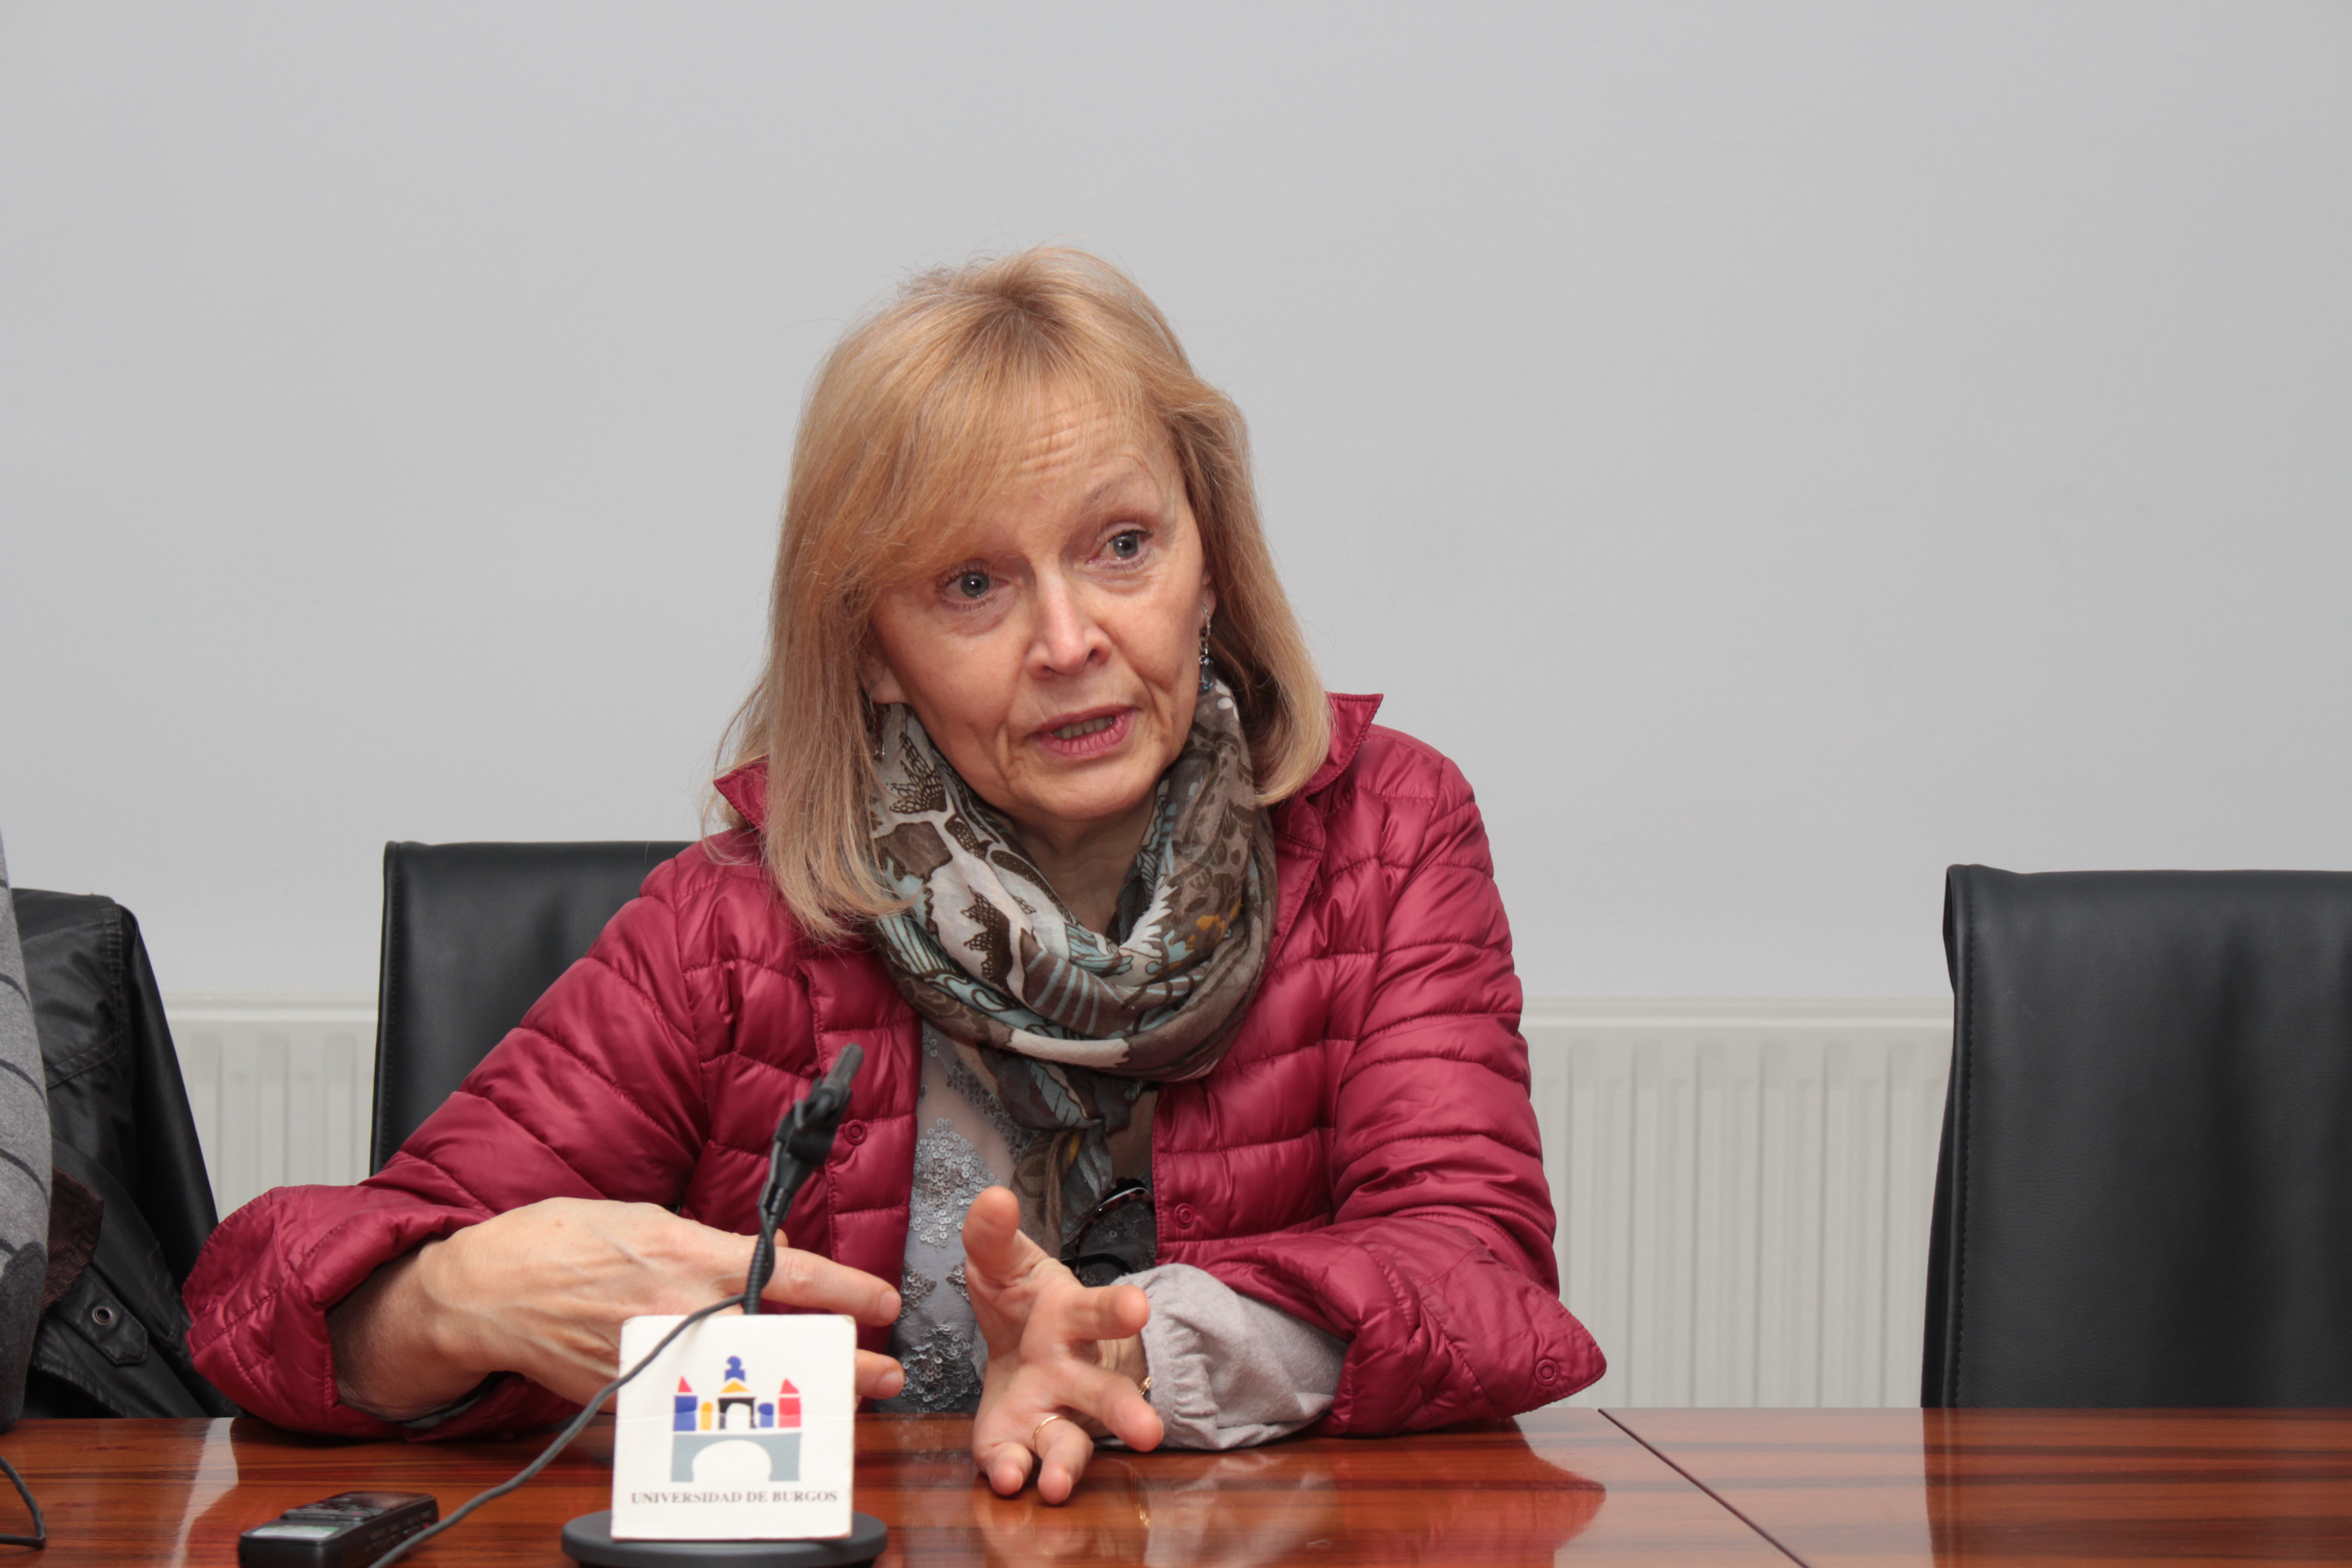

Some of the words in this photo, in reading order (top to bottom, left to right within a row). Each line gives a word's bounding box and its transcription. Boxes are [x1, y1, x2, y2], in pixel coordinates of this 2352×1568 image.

[632, 1491, 741, 1504] UNIVERSIDAD
[746, 1491, 768, 1502] DE
[773, 1490, 838, 1502] BURGOS
